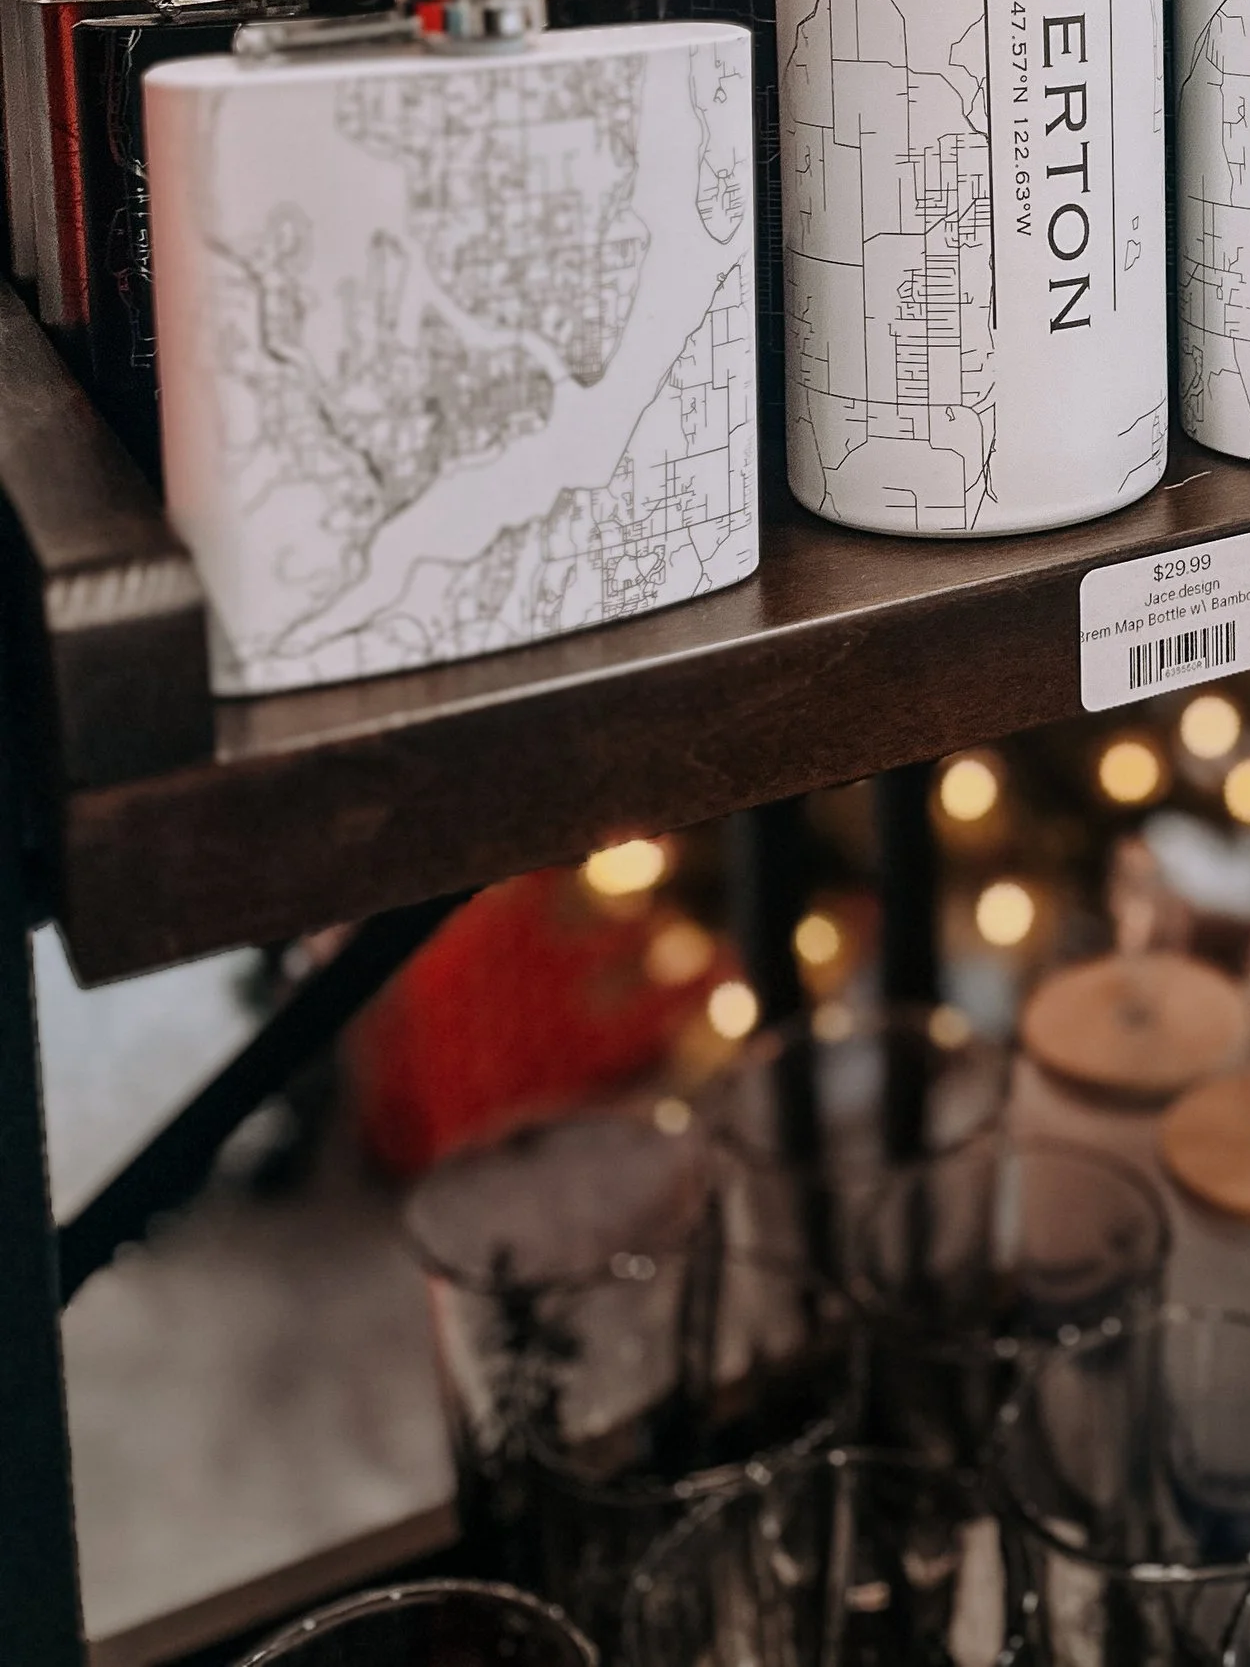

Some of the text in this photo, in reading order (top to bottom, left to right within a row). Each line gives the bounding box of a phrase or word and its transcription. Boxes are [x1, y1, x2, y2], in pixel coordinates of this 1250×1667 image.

[1010, 0, 1029, 104] 47.57°N
[1013, 117, 1032, 237] 122.63°W
[1153, 553, 1212, 583] $29.99
[1115, 618, 1145, 635] Map
[1148, 605, 1187, 627] Bottle
